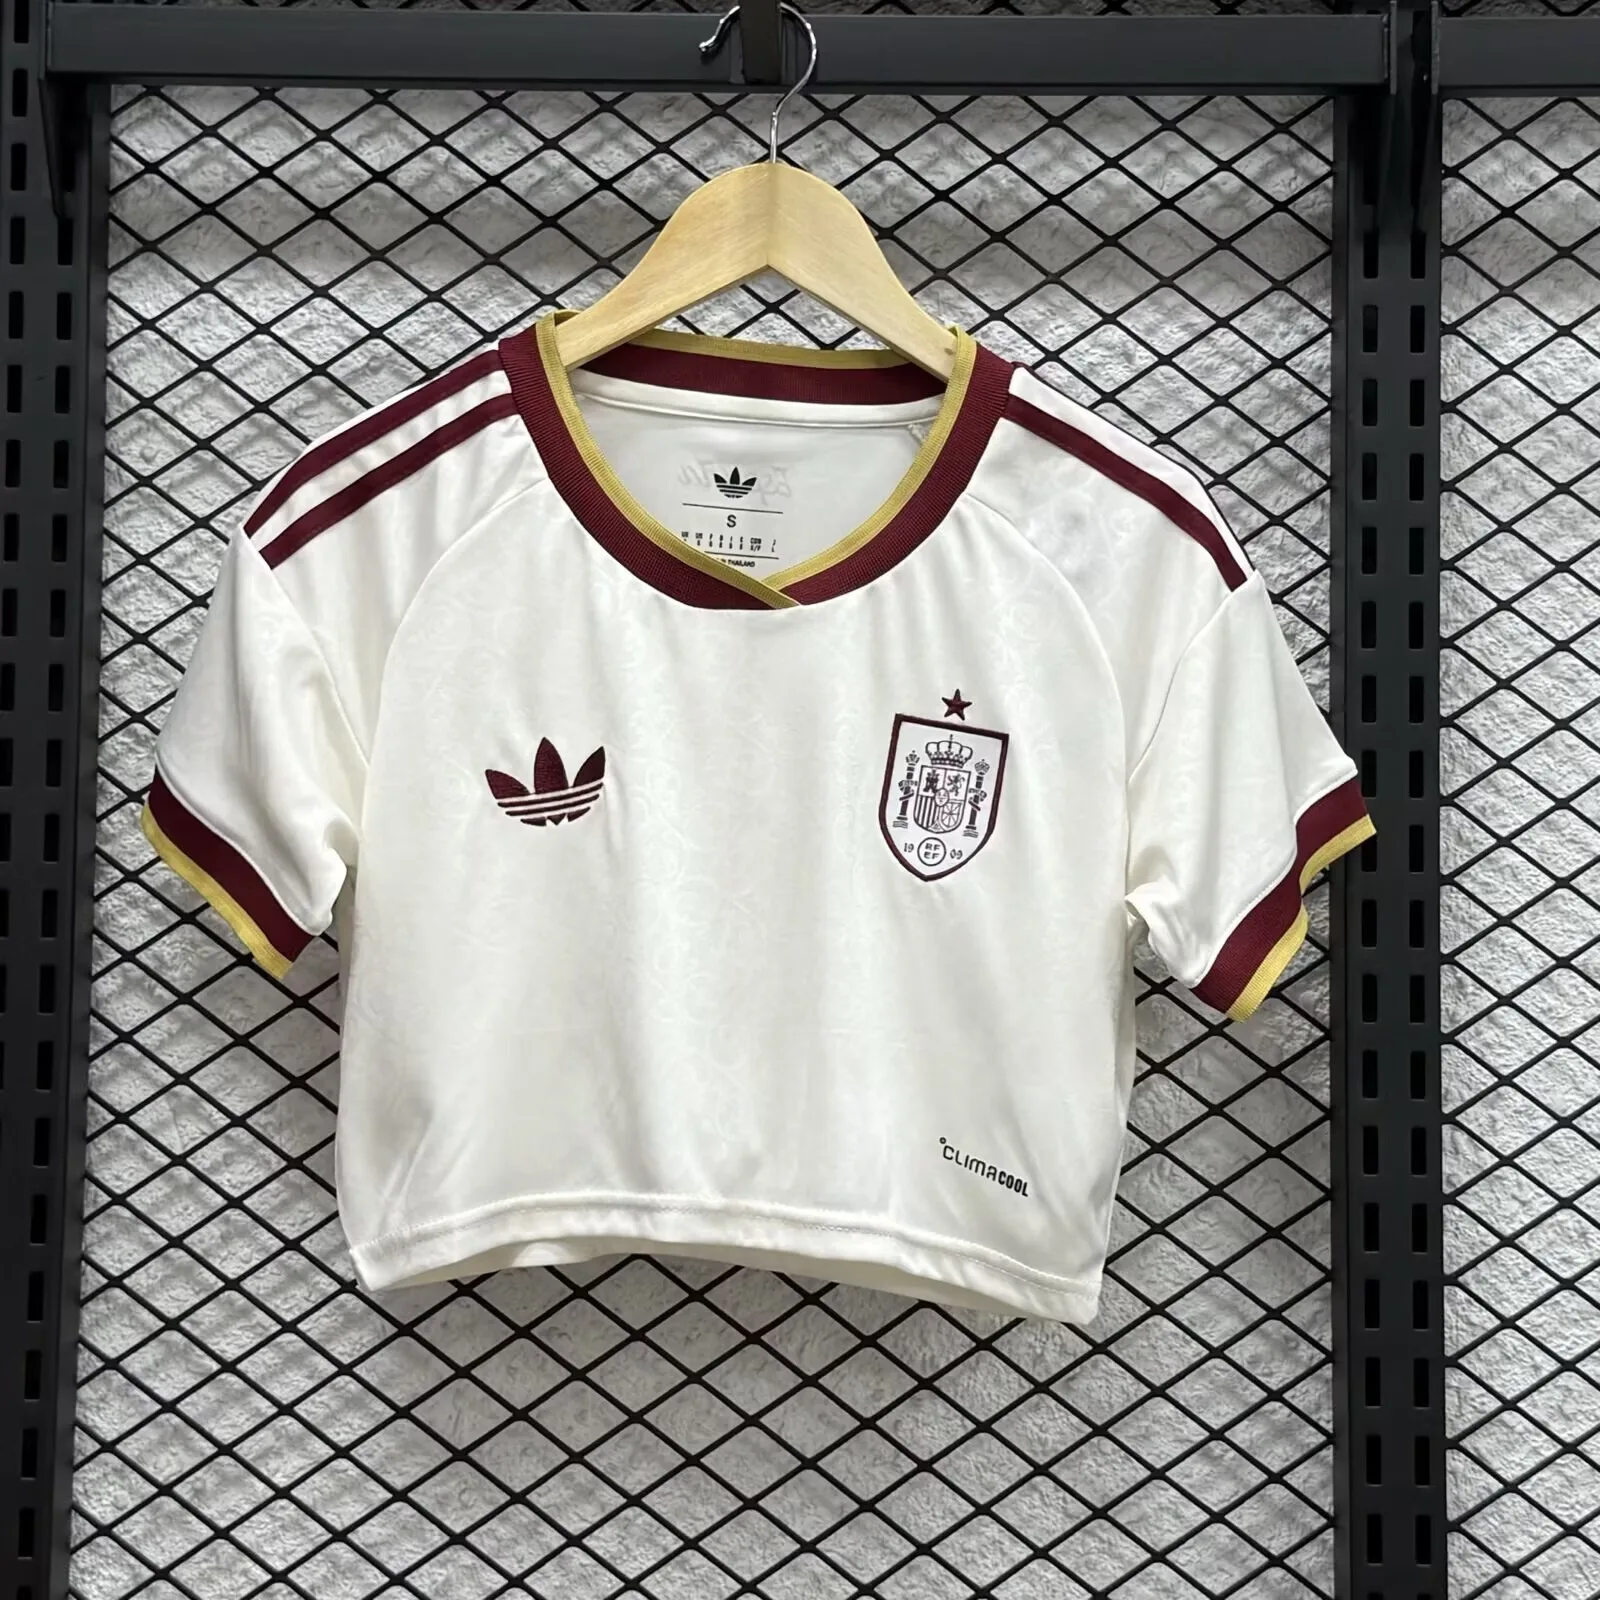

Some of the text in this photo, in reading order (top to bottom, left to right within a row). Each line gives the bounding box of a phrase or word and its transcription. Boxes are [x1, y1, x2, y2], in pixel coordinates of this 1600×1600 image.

[726, 514, 737, 528] S
[904, 843, 914, 853] 19
[925, 843, 941, 851] RF
[923, 851, 940, 859] EF
